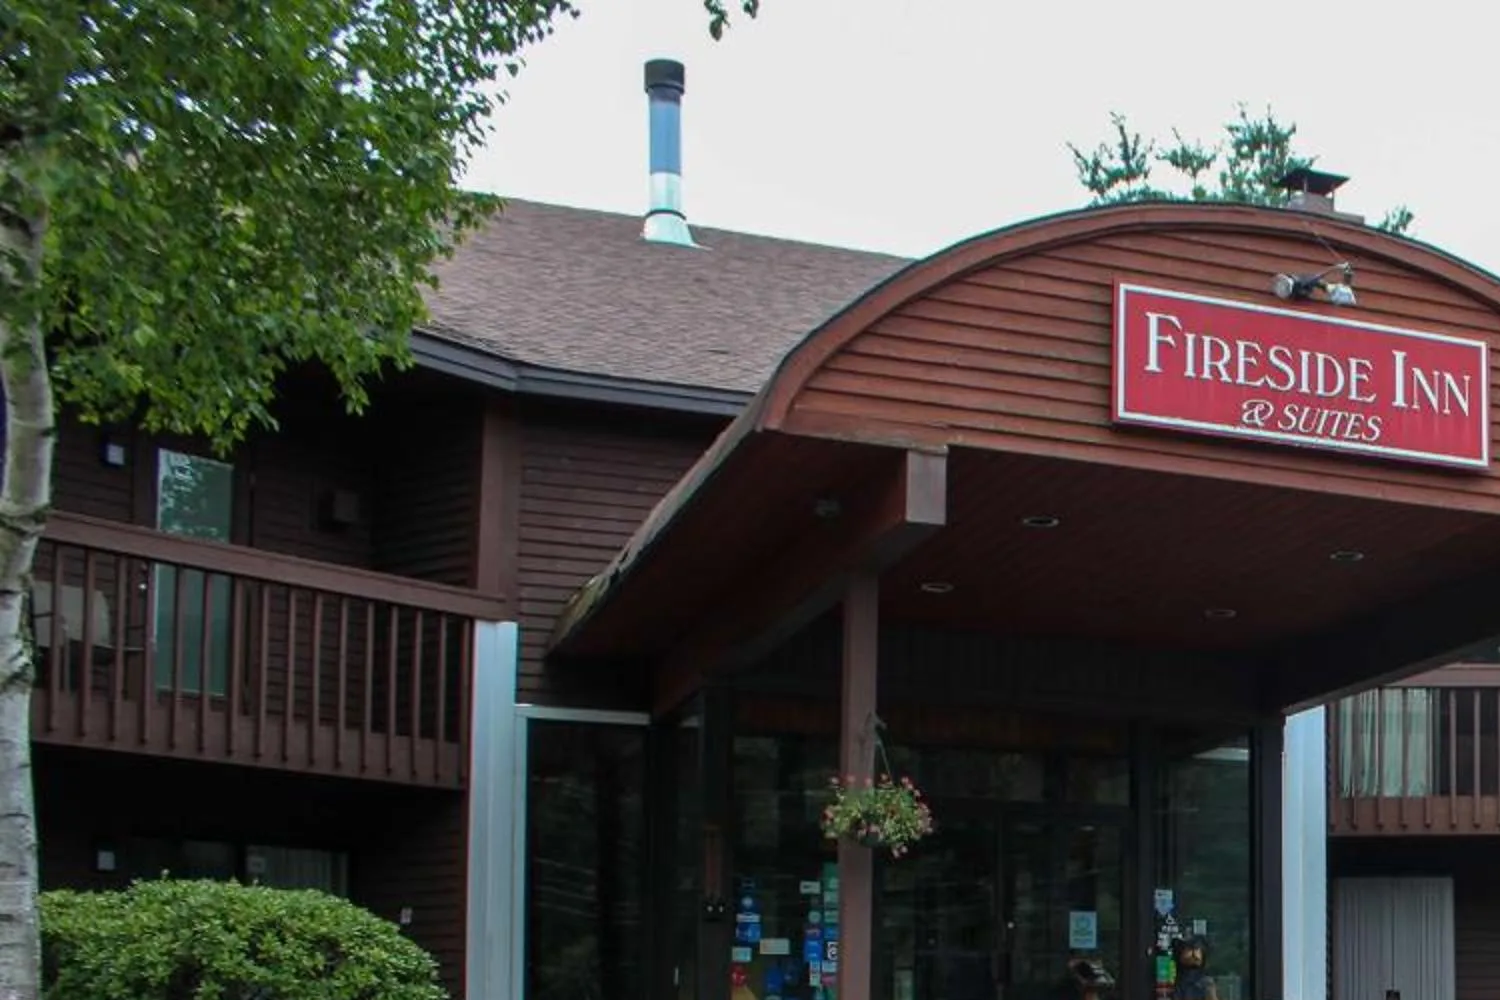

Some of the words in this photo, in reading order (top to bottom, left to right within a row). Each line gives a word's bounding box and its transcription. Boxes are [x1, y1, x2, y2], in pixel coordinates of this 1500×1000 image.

[1144, 311, 1377, 403] FIRESIDE
[1392, 349, 1471, 417] INN
[1241, 399, 1274, 427] &
[1278, 404, 1383, 442] SUITES
